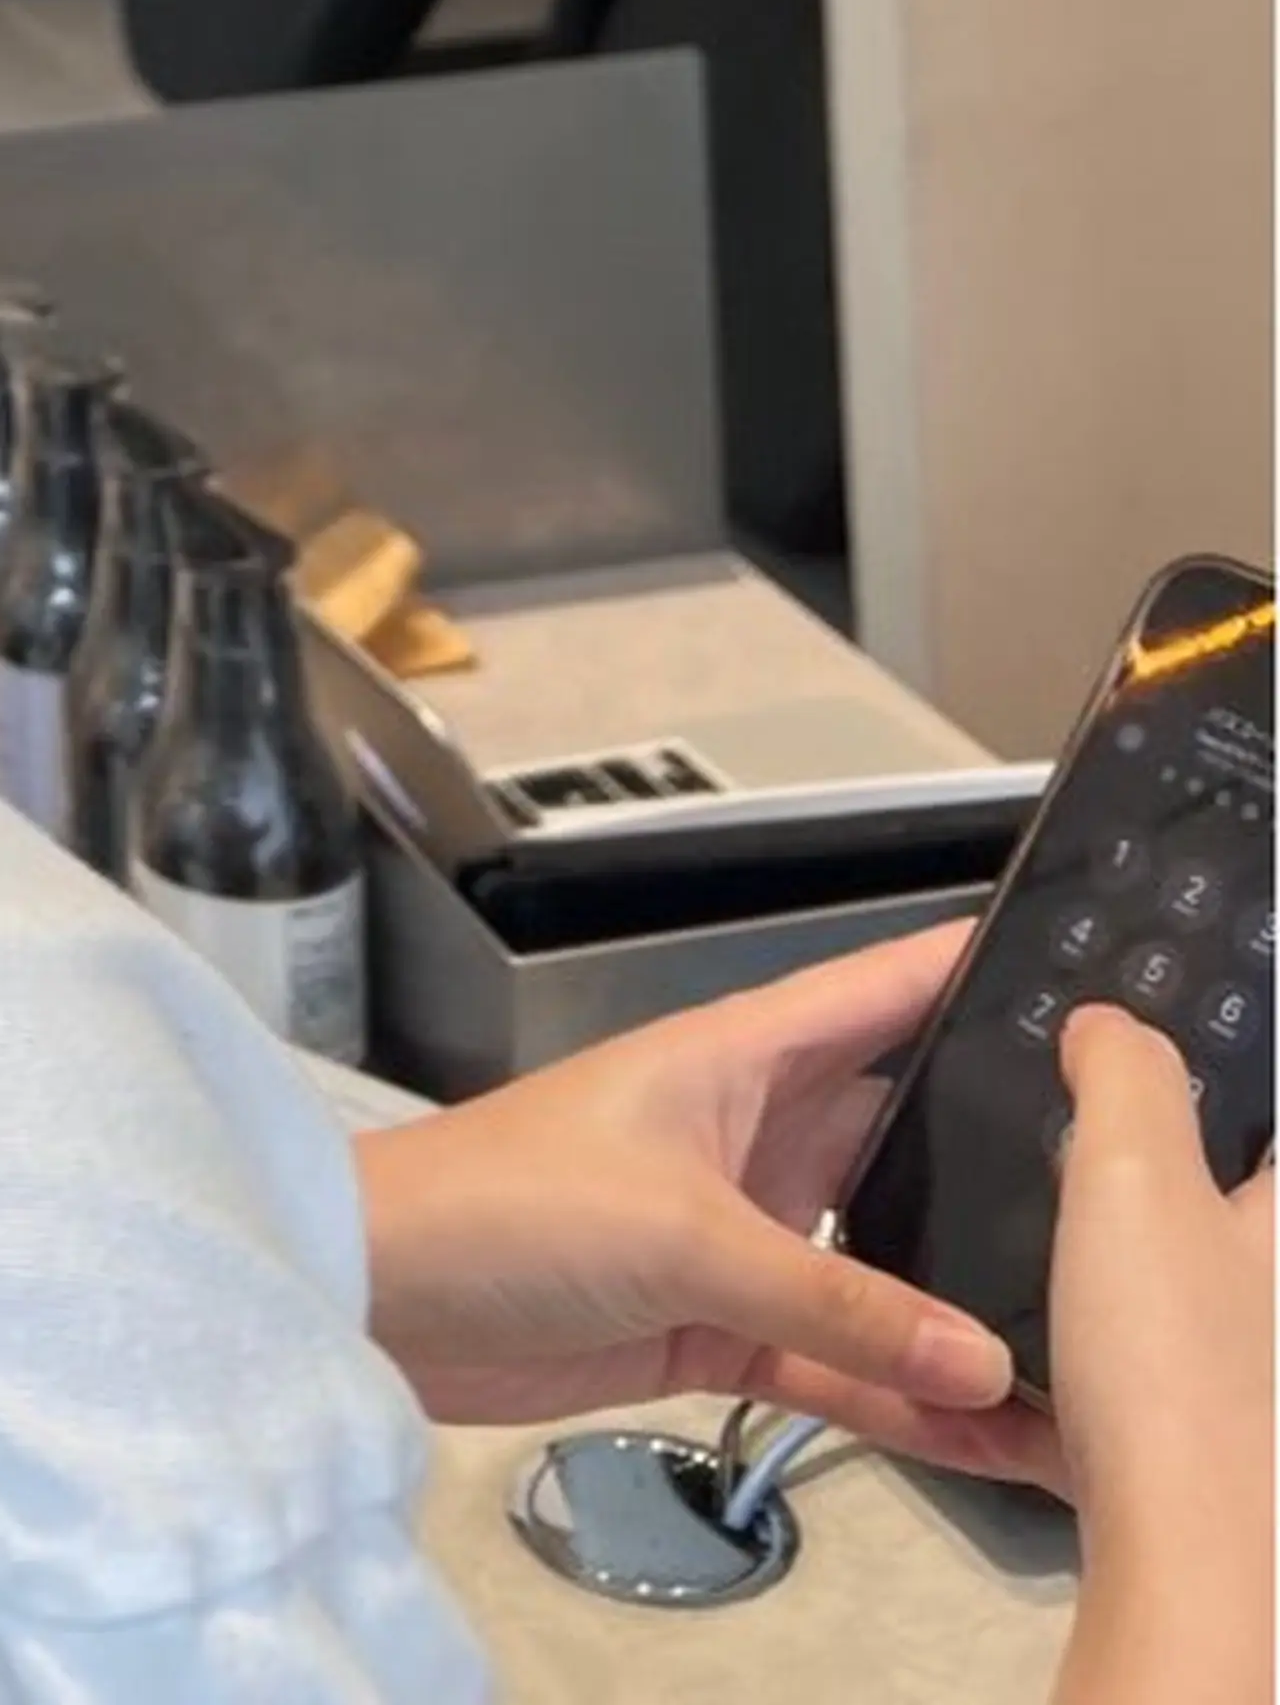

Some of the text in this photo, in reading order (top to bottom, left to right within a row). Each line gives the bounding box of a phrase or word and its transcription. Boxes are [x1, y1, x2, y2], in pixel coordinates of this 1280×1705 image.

[1113, 838, 1130, 868] 1
[1181, 875, 1207, 906] 2
[1069, 916, 1094, 943] 4
[1143, 954, 1171, 983] 5
[1032, 992, 1056, 1019] 7
[1219, 992, 1245, 1024] 6
